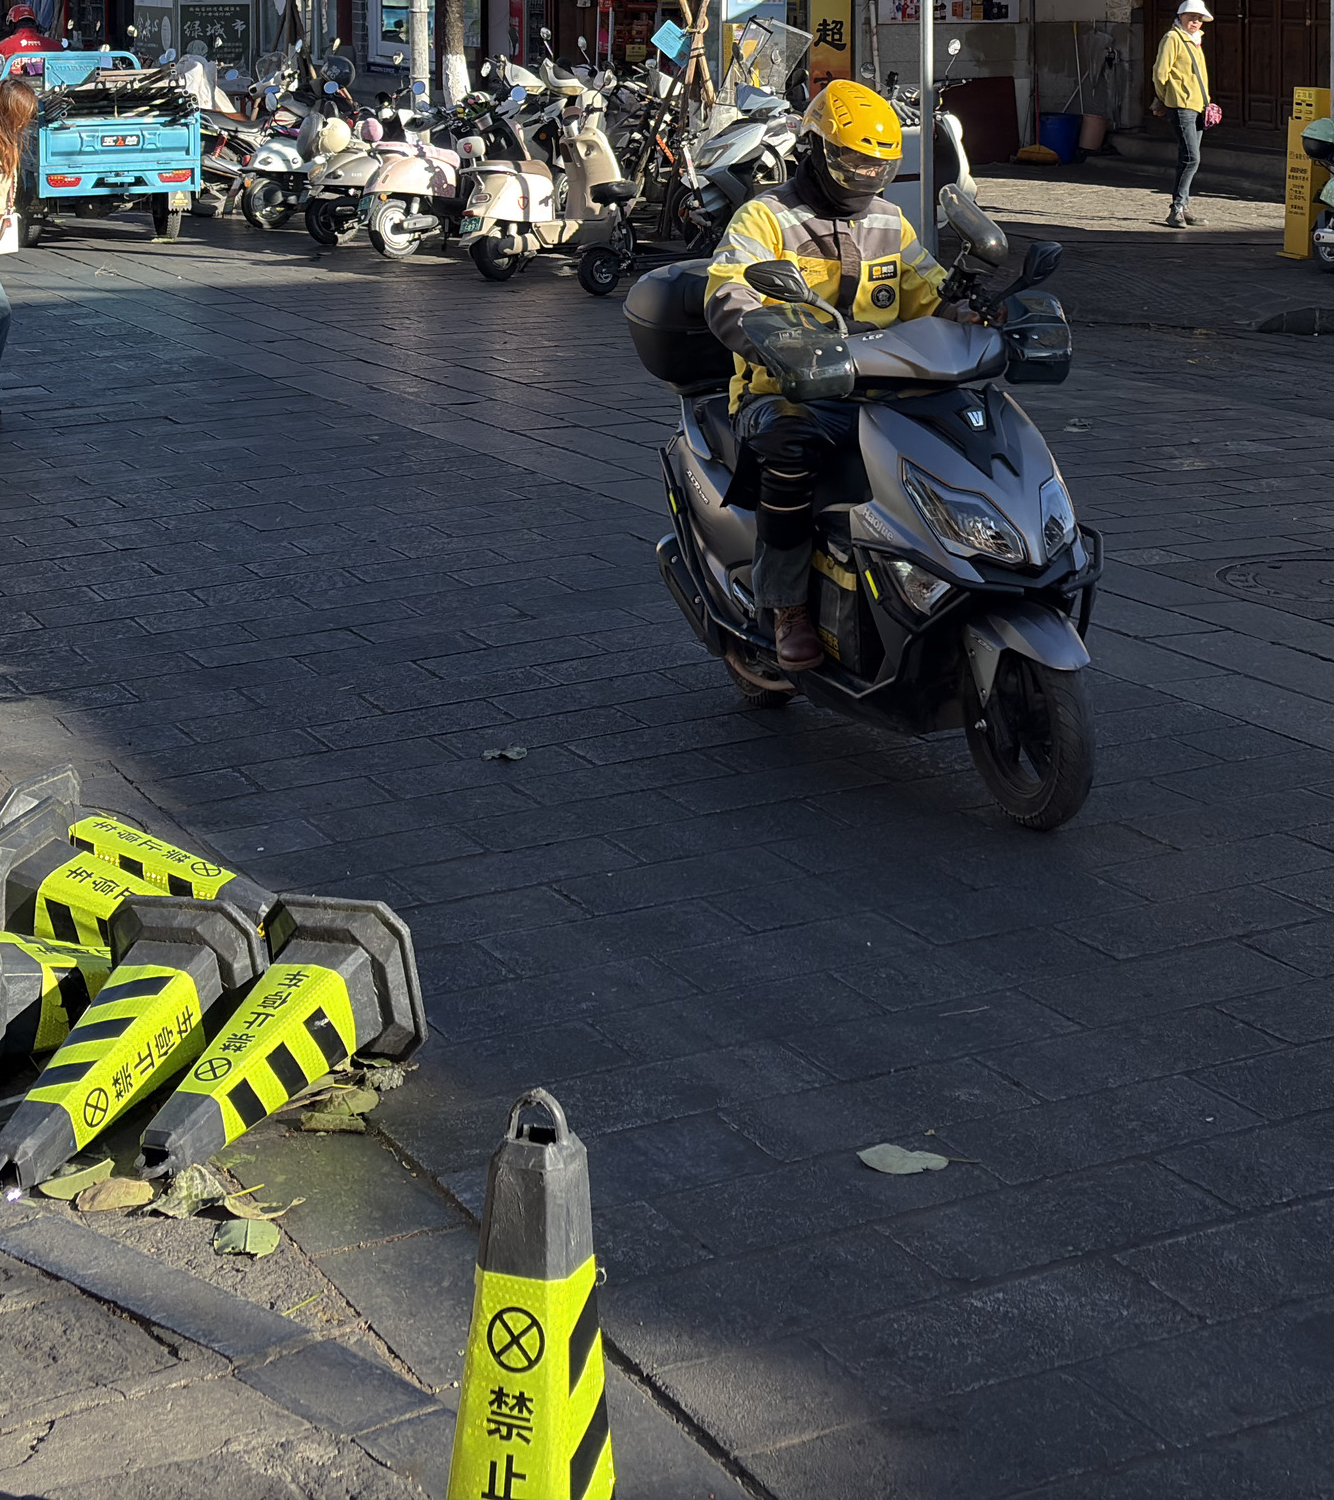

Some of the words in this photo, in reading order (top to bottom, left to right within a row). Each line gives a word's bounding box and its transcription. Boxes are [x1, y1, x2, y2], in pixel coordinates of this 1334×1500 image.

[183, 19, 246, 39] 绿城市
[863, 507, 895, 542] Haojue
[93, 820, 192, 864] 禁止停车
[218, 970, 311, 1054] 禁止停车
[111, 1004, 194, 1102] 禁止停车
[480, 1386, 535, 1500] 禁止
